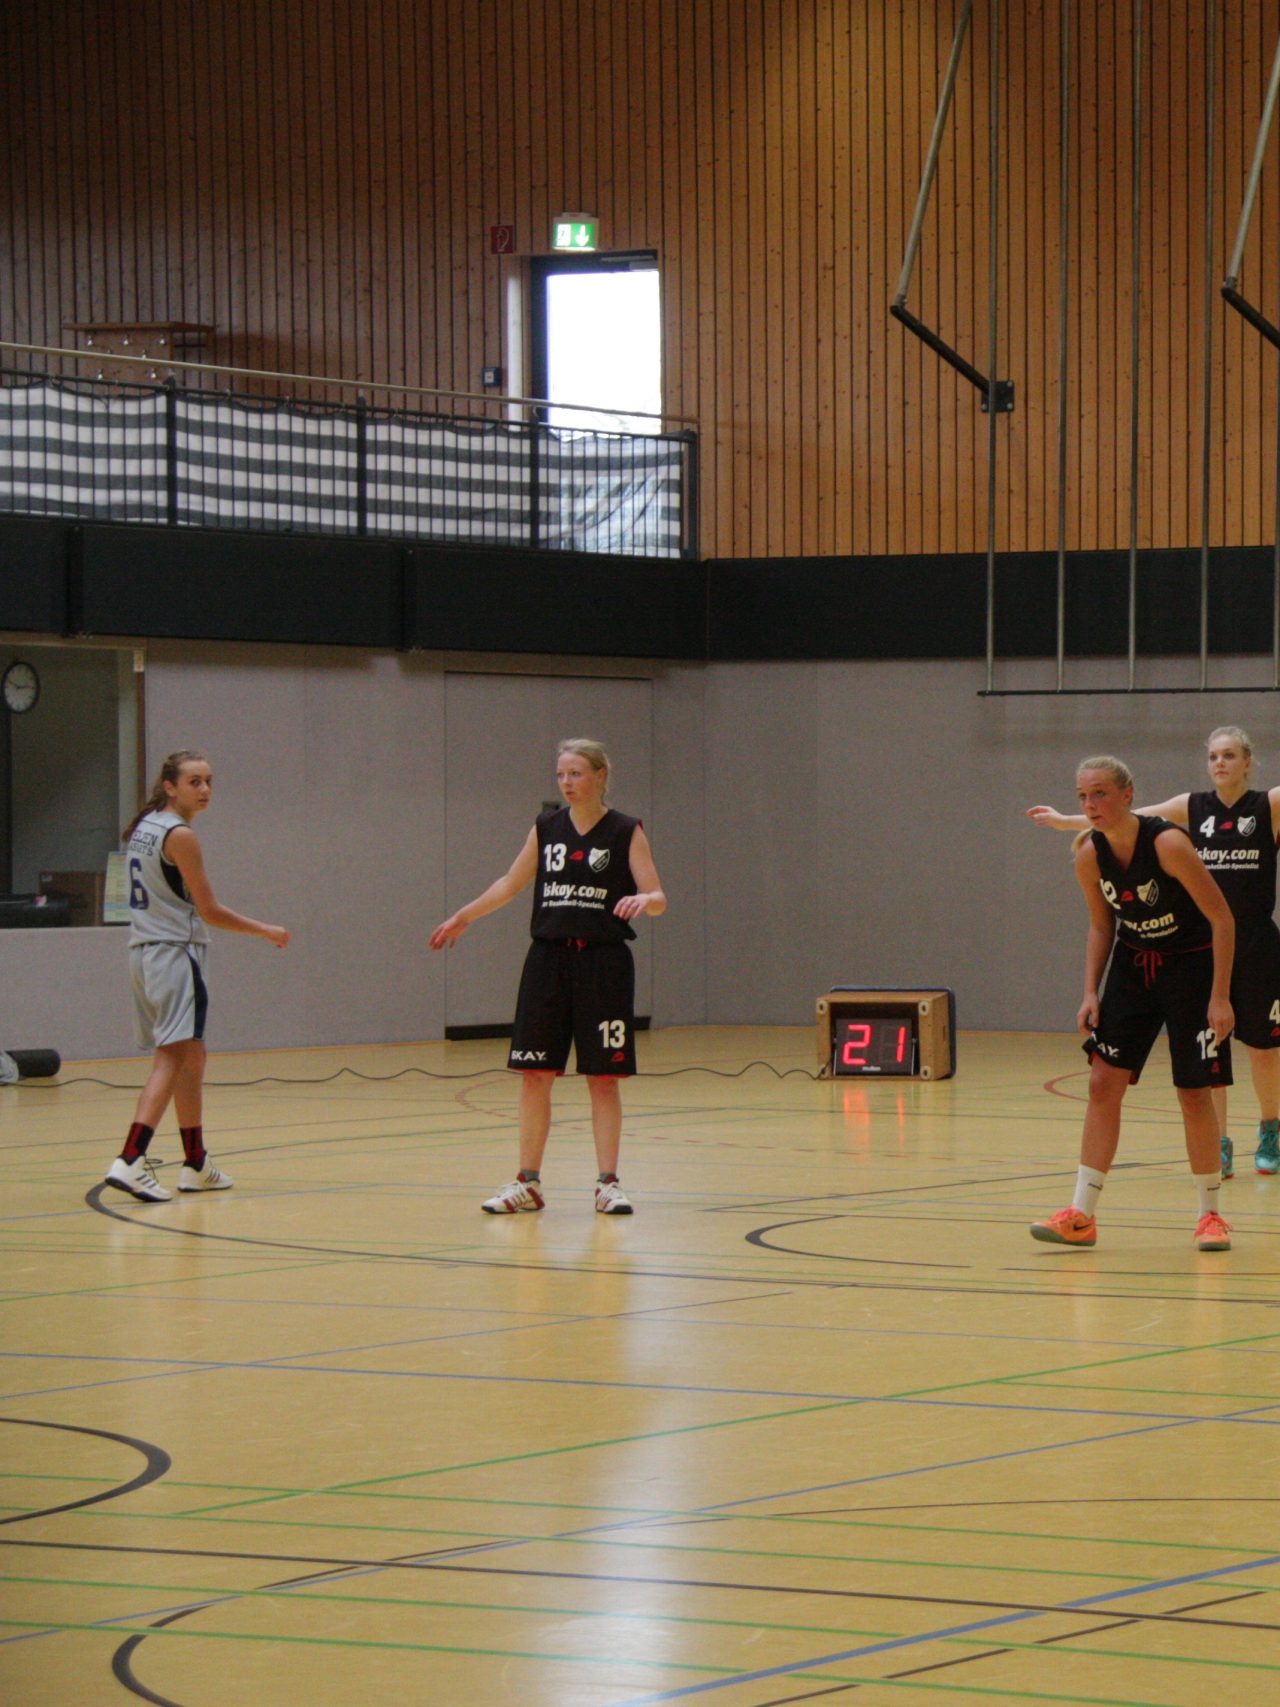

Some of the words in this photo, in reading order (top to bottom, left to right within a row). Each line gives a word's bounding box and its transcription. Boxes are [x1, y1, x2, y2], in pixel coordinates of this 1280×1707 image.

[1200, 815, 1216, 839] 4
[543, 842, 568, 872] 13
[1195, 847, 1260, 864] skay.com
[130, 857, 150, 910] 6
[543, 881, 608, 900] iskay.com
[598, 1019, 626, 1049] 13
[842, 1024, 907, 1065] 21
[1196, 1028, 1218, 1060] 12
